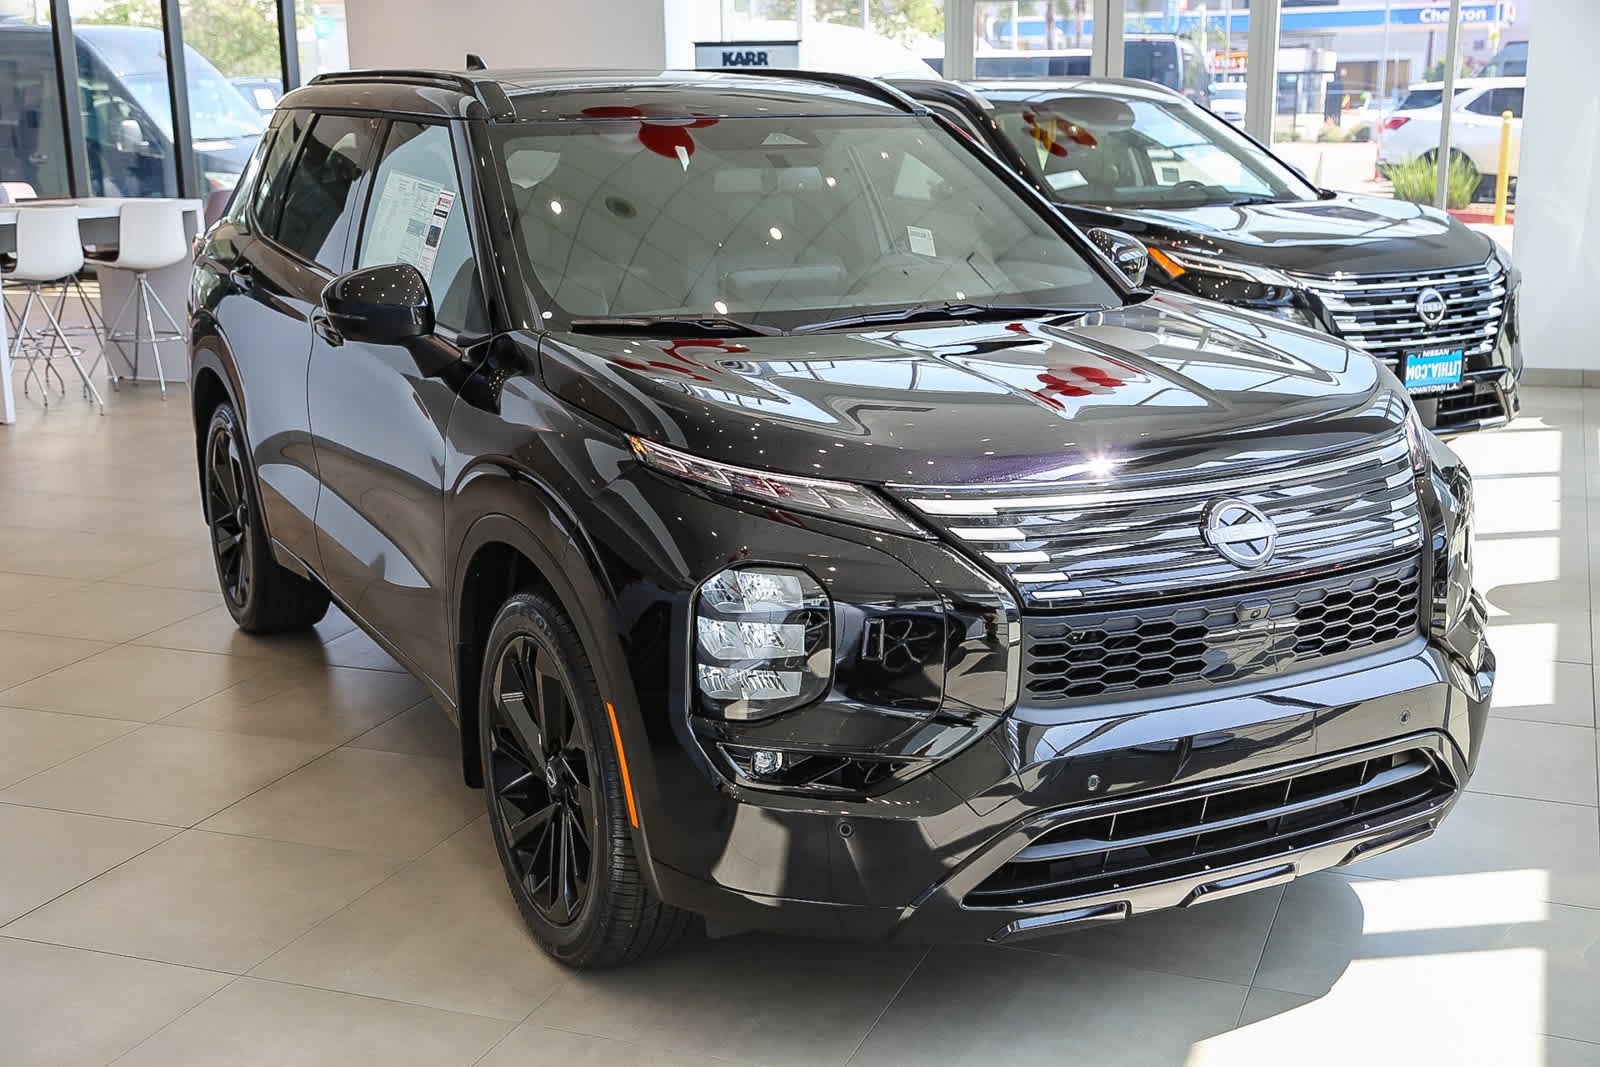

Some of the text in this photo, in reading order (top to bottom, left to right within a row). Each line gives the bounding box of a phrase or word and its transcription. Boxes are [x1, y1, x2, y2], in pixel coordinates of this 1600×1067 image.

[1420, 8, 1487, 23] Cheron
[722, 51, 768, 66] KARR
[1422, 348, 1449, 358] NISSAN
[1405, 360, 1462, 380] LITHIA.COM
[1408, 384, 1446, 395] DOWNTOWN
[1209, 519, 1275, 543] NISS
